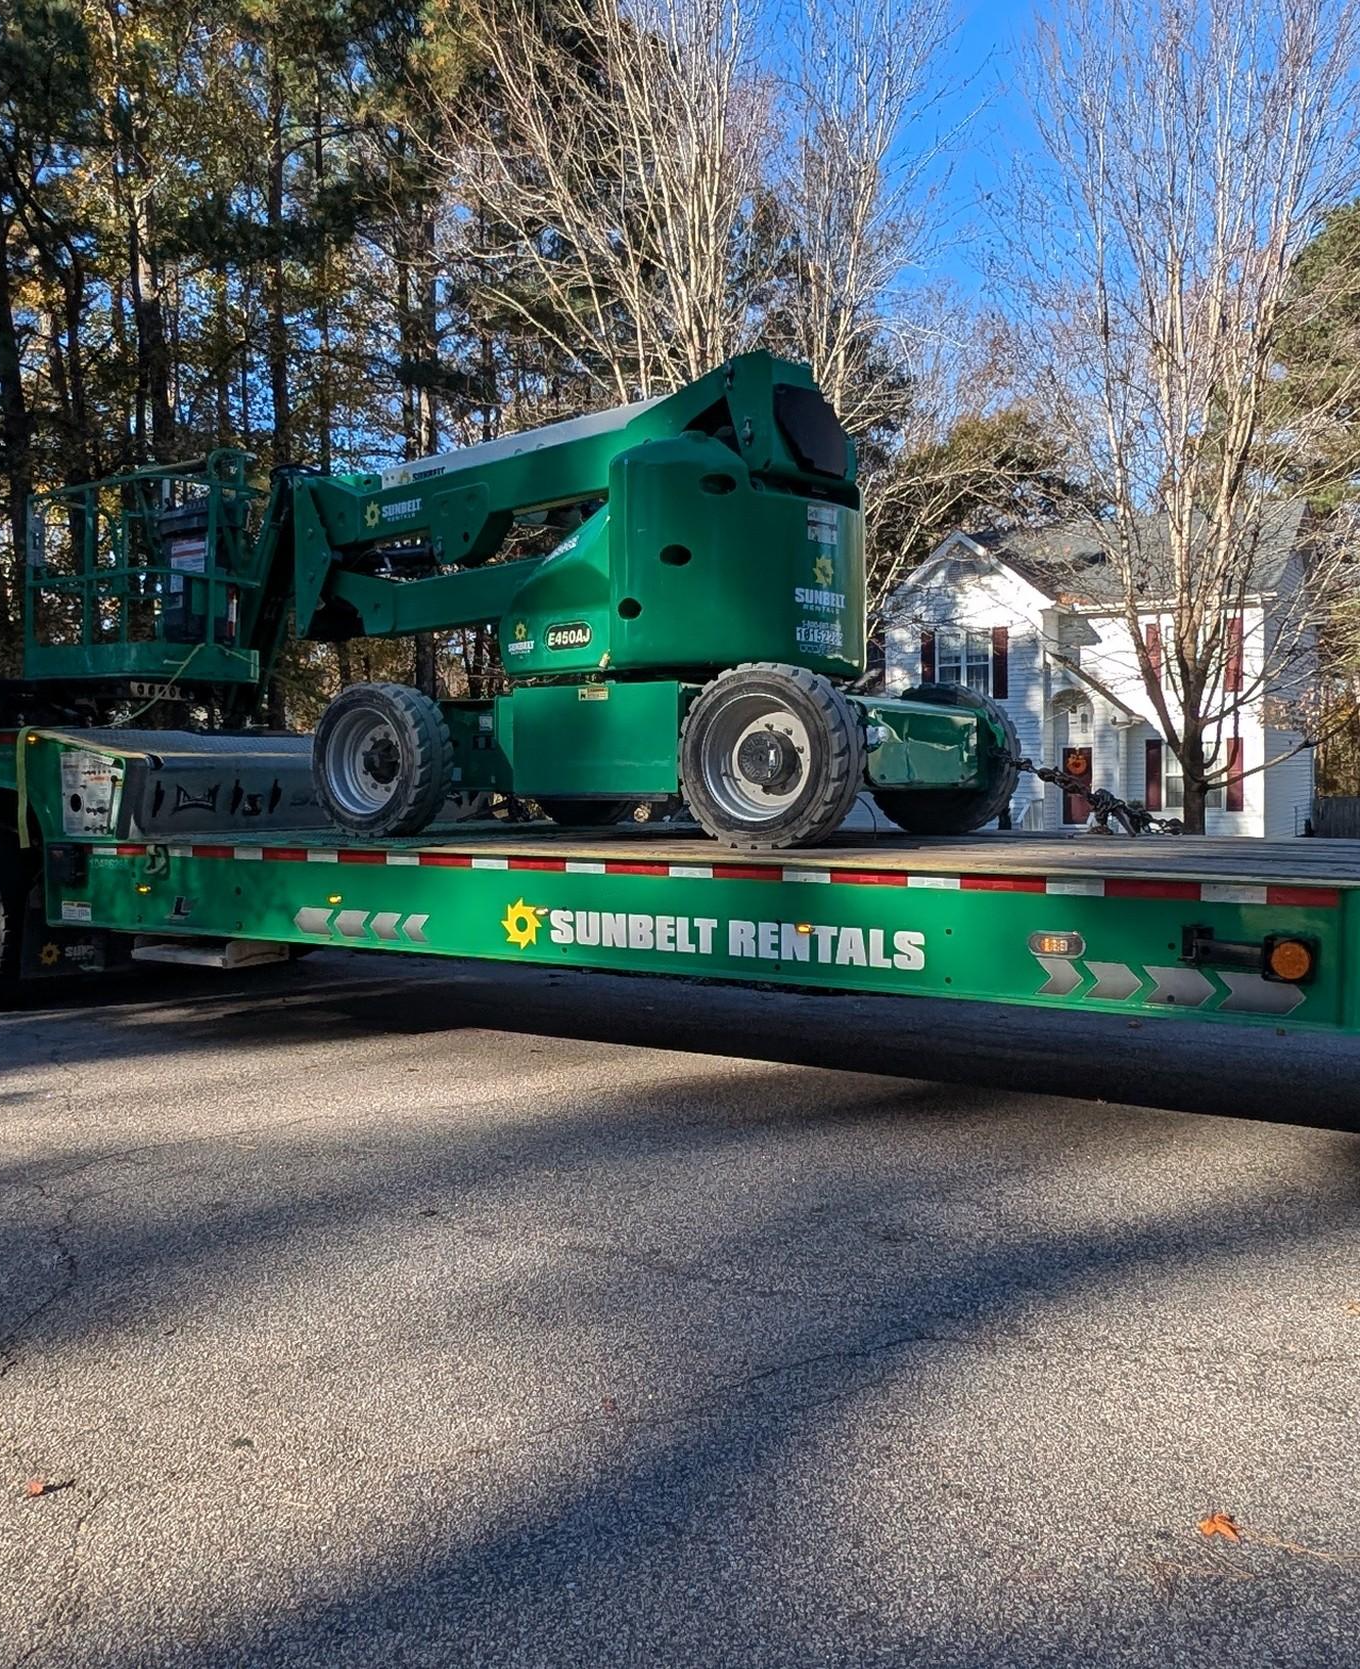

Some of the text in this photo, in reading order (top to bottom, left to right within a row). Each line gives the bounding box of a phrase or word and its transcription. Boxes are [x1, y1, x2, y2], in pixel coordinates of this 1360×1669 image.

[381, 498, 422, 518] SUNBELT
[794, 587, 846, 609] SUNBELT
[547, 627, 591, 646] E450AJ
[550, 909, 926, 971] SUNBELT RENTALS
